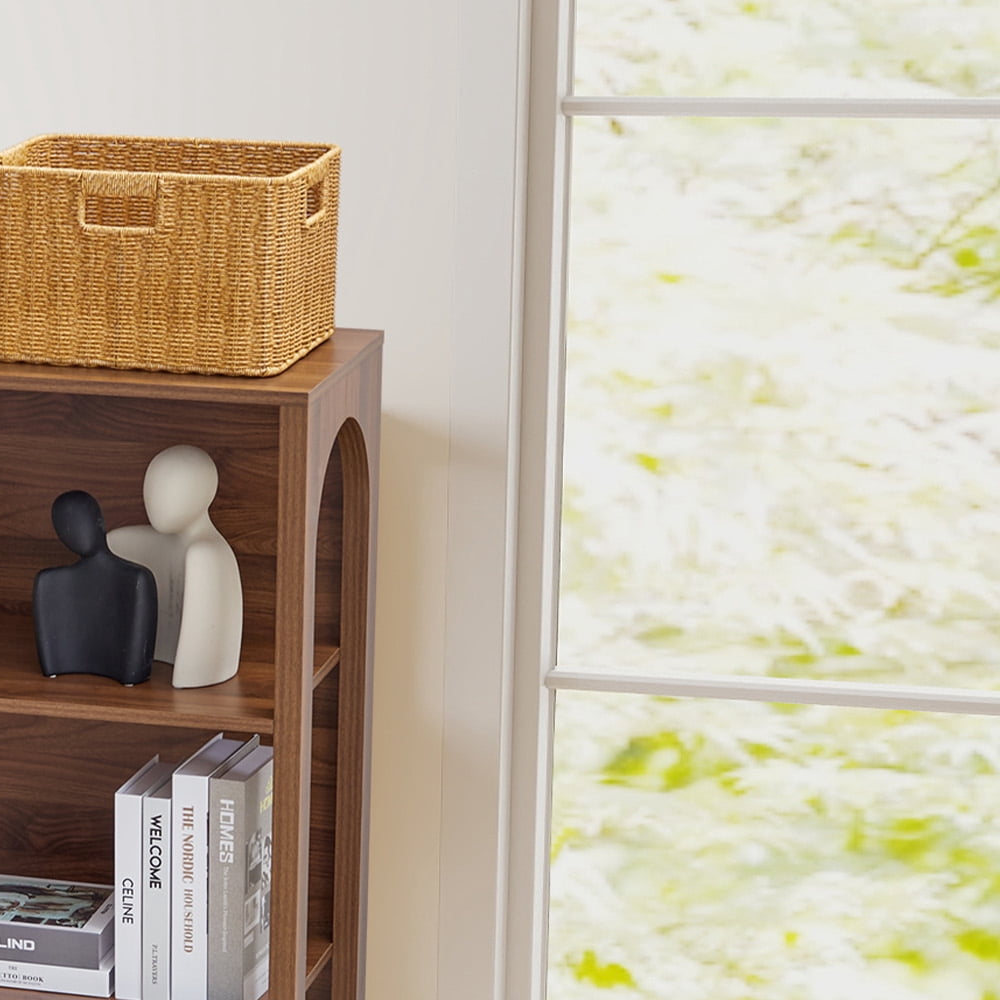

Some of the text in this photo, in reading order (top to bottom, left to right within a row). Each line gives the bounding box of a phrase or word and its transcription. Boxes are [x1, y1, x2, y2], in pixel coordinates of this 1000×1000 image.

[149, 814, 162, 889] WELCOME
[218, 799, 235, 864] HOMES
[121, 877, 134, 925] CELINE
[181, 805, 194, 953] THE NORDIC HOUSEHOLD
[22, 974, 44, 983] BOOK
